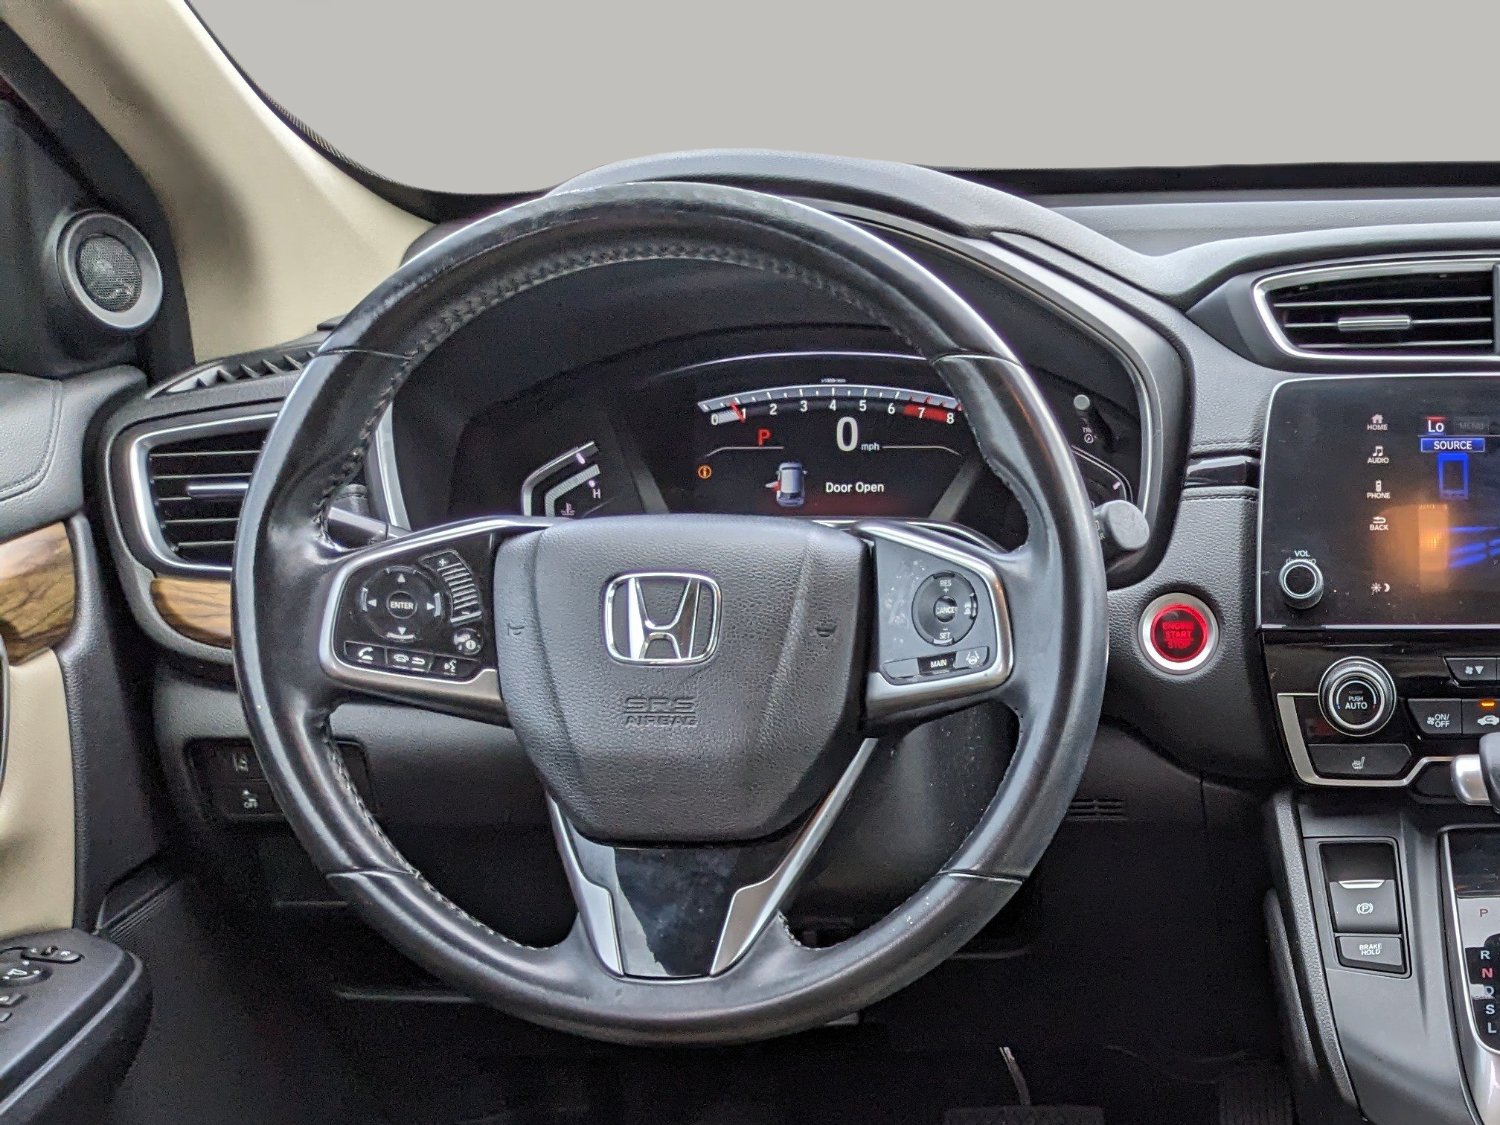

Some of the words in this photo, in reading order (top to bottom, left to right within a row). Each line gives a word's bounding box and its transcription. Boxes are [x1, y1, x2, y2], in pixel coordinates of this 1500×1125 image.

[711, 414, 719, 426] 0
[769, 403, 778, 415] 2
[800, 401, 808, 412] 3
[829, 400, 837, 411] 4
[859, 400, 867, 411] 5
[887, 402, 896, 414] 6
[917, 408, 925, 419] 7
[946, 413, 955, 424] 8
[1427, 419, 1445, 433] Lo
[757, 429, 771, 446] P
[836, 416, 859, 452] 0
[861, 442, 880, 452] mph
[1433, 440, 1473, 450] SOURCE
[592, 488, 601, 499] H
[825, 482, 852, 493] Door
[855, 482, 885, 496] Open
[390, 601, 414, 610] ENTER
[940, 632, 951, 640] SET
[1165, 630, 1193, 639] START
[930, 660, 947, 668] MAIN
[1345, 702, 1368, 710] AUTO
[1434, 713, 1450, 721] ON/
[1434, 721, 1450, 729] OFF
[1480, 908, 1488, 917] P
[1359, 943, 1383, 951] BRAKE
[1480, 950, 1491, 960] R
[1481, 968, 1493, 978] N
[1485, 1004, 1495, 1015] S
[1487, 1022, 1497, 1034] L
